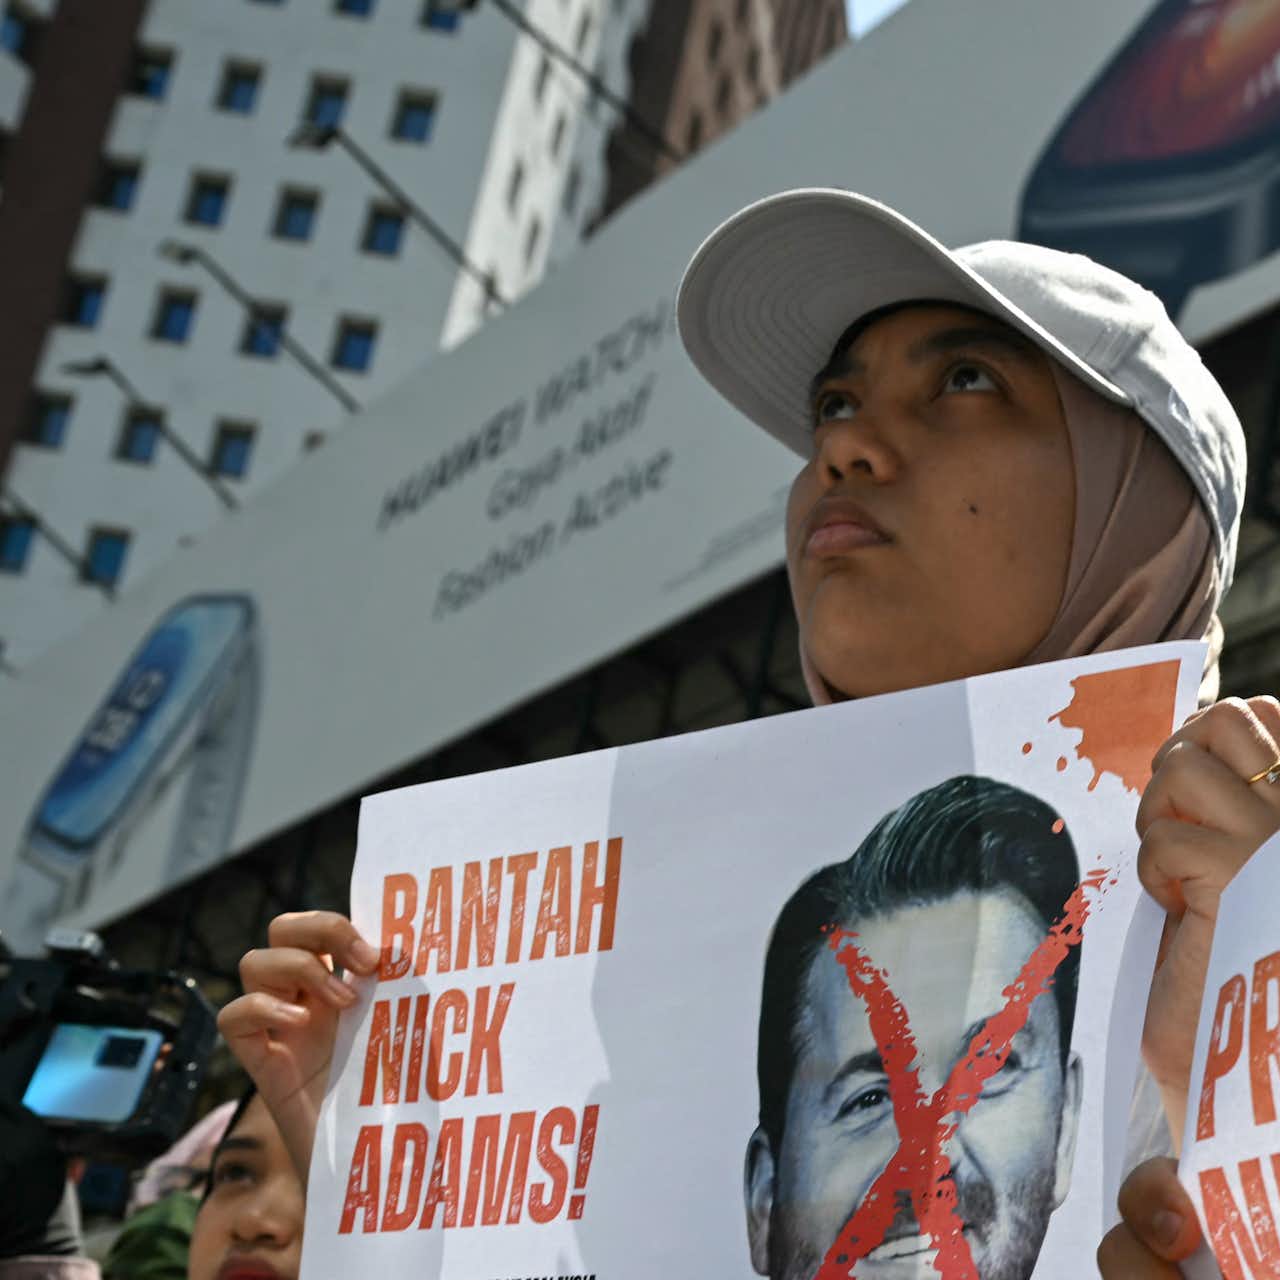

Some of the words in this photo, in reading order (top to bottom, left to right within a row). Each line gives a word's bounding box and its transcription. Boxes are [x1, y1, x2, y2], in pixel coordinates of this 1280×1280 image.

[376, 398, 526, 534] HUAWEI
[559, 448, 672, 544] Active
[376, 836, 624, 982] BANTAH
[358, 981, 517, 1107] NICK
[337, 1104, 601, 1235] ADAMS!
